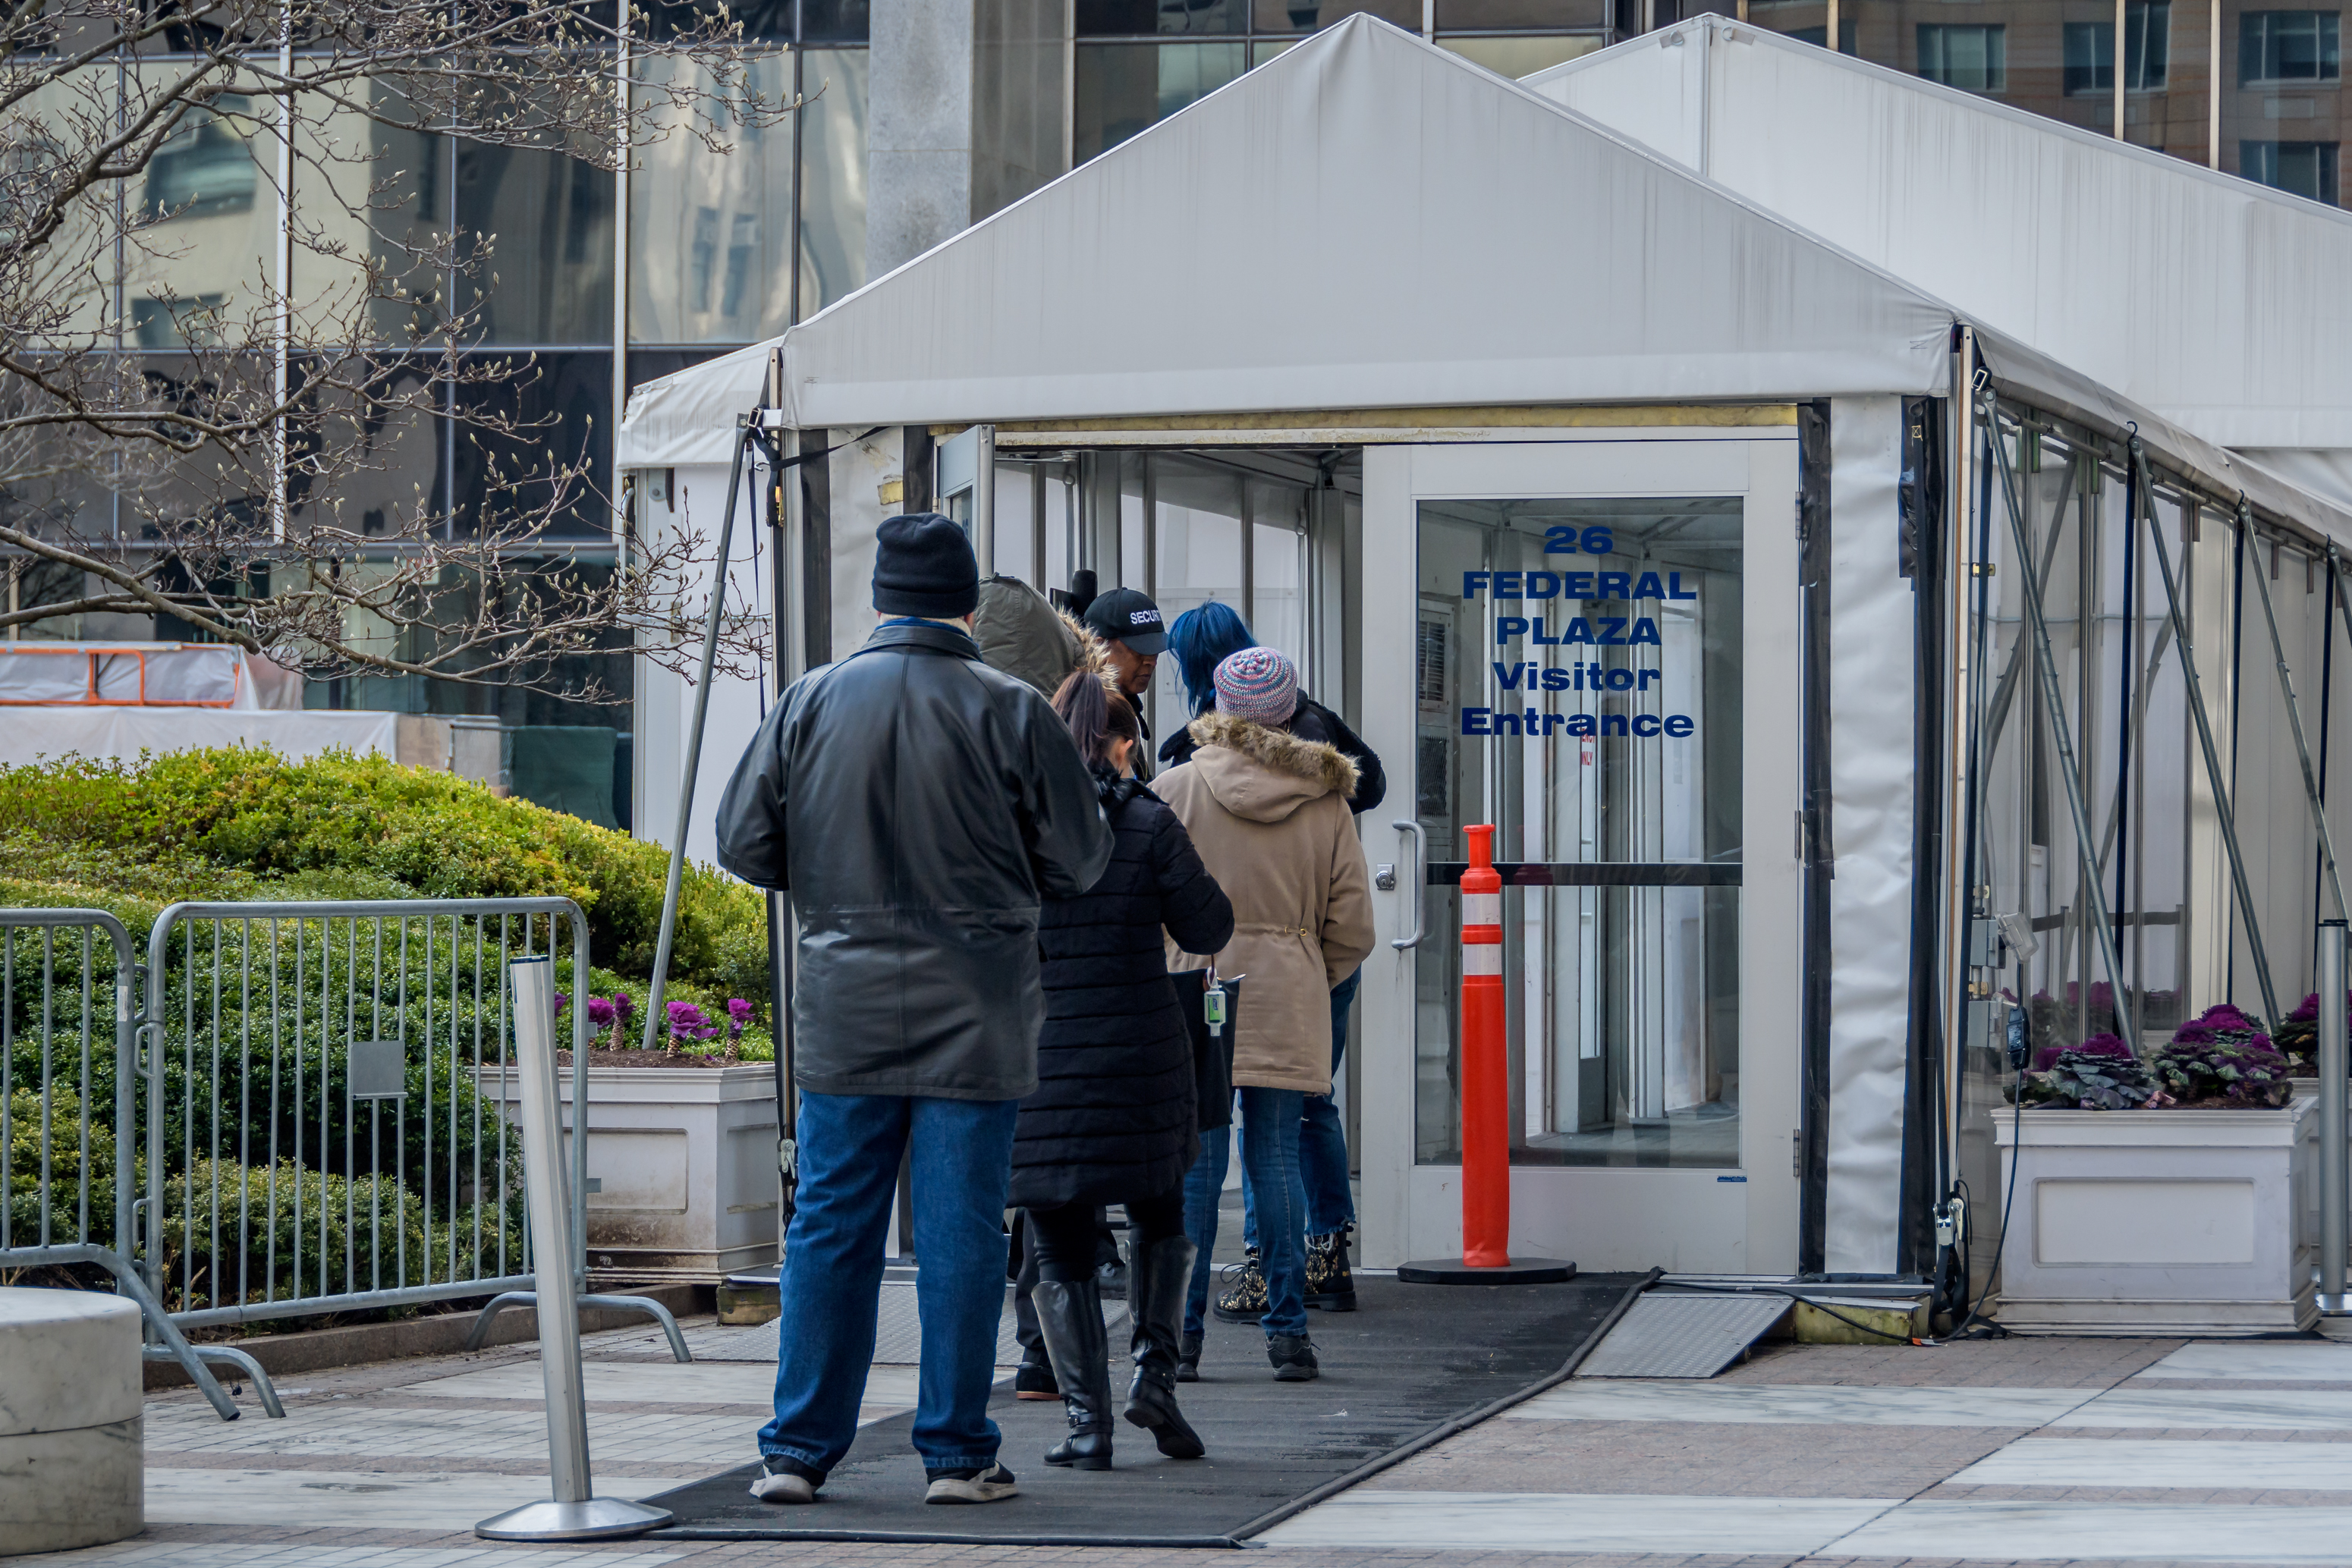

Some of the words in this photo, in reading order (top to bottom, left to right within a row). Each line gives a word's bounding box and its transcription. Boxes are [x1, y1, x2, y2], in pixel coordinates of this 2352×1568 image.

[1544, 526, 1613, 555] 26
[1464, 571, 1696, 599] FEDERAL
[1498, 617, 1661, 645] PLAZA
[1492, 662, 1660, 691] Visitor
[1462, 708, 1693, 737] Entrance
[1580, 751, 1593, 766] NLY
